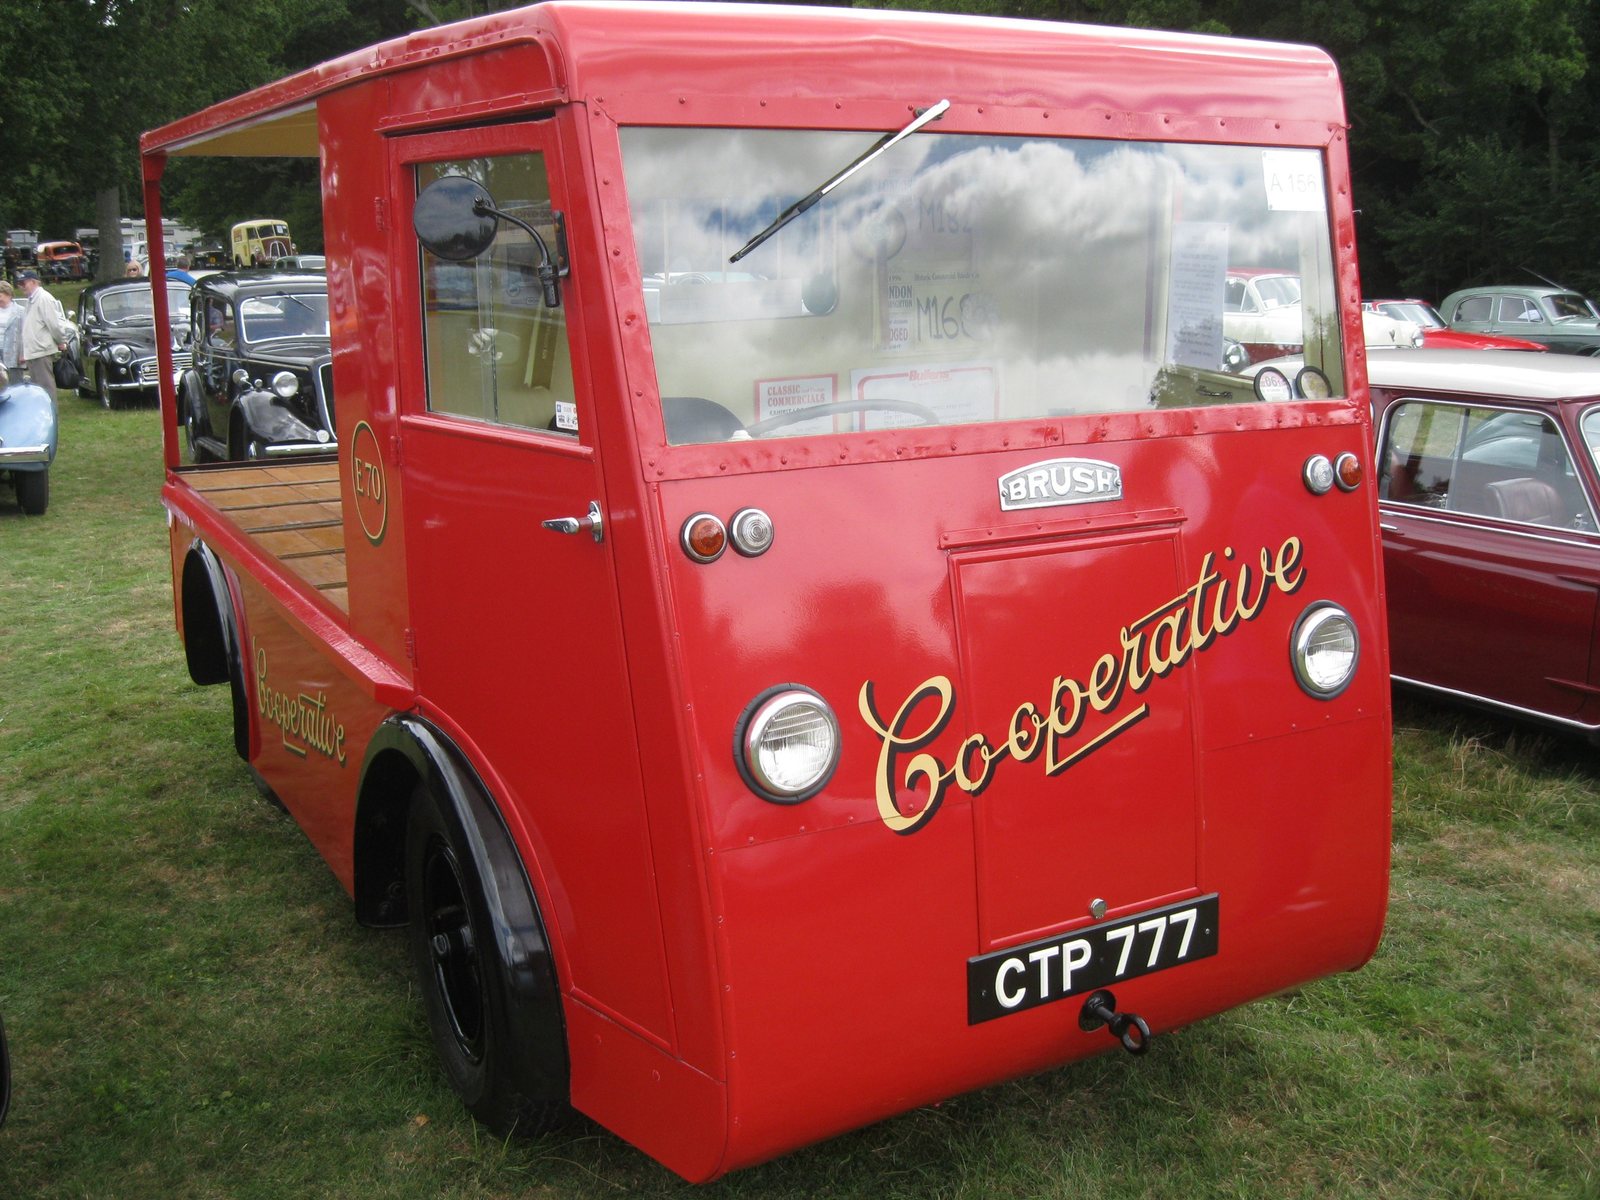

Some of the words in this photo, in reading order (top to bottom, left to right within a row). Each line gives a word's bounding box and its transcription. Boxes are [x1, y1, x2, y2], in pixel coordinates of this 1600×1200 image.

[1270, 172, 1284, 193] A
[767, 384, 800, 396] CLASSIC
[767, 393, 826, 407] COMMERCIALS
[355, 457, 364, 493] E
[364, 462, 381, 500] 70
[1008, 466, 1115, 501] BRUSH
[994, 938, 1093, 1009] CTP
[1106, 907, 1198, 977] 777
